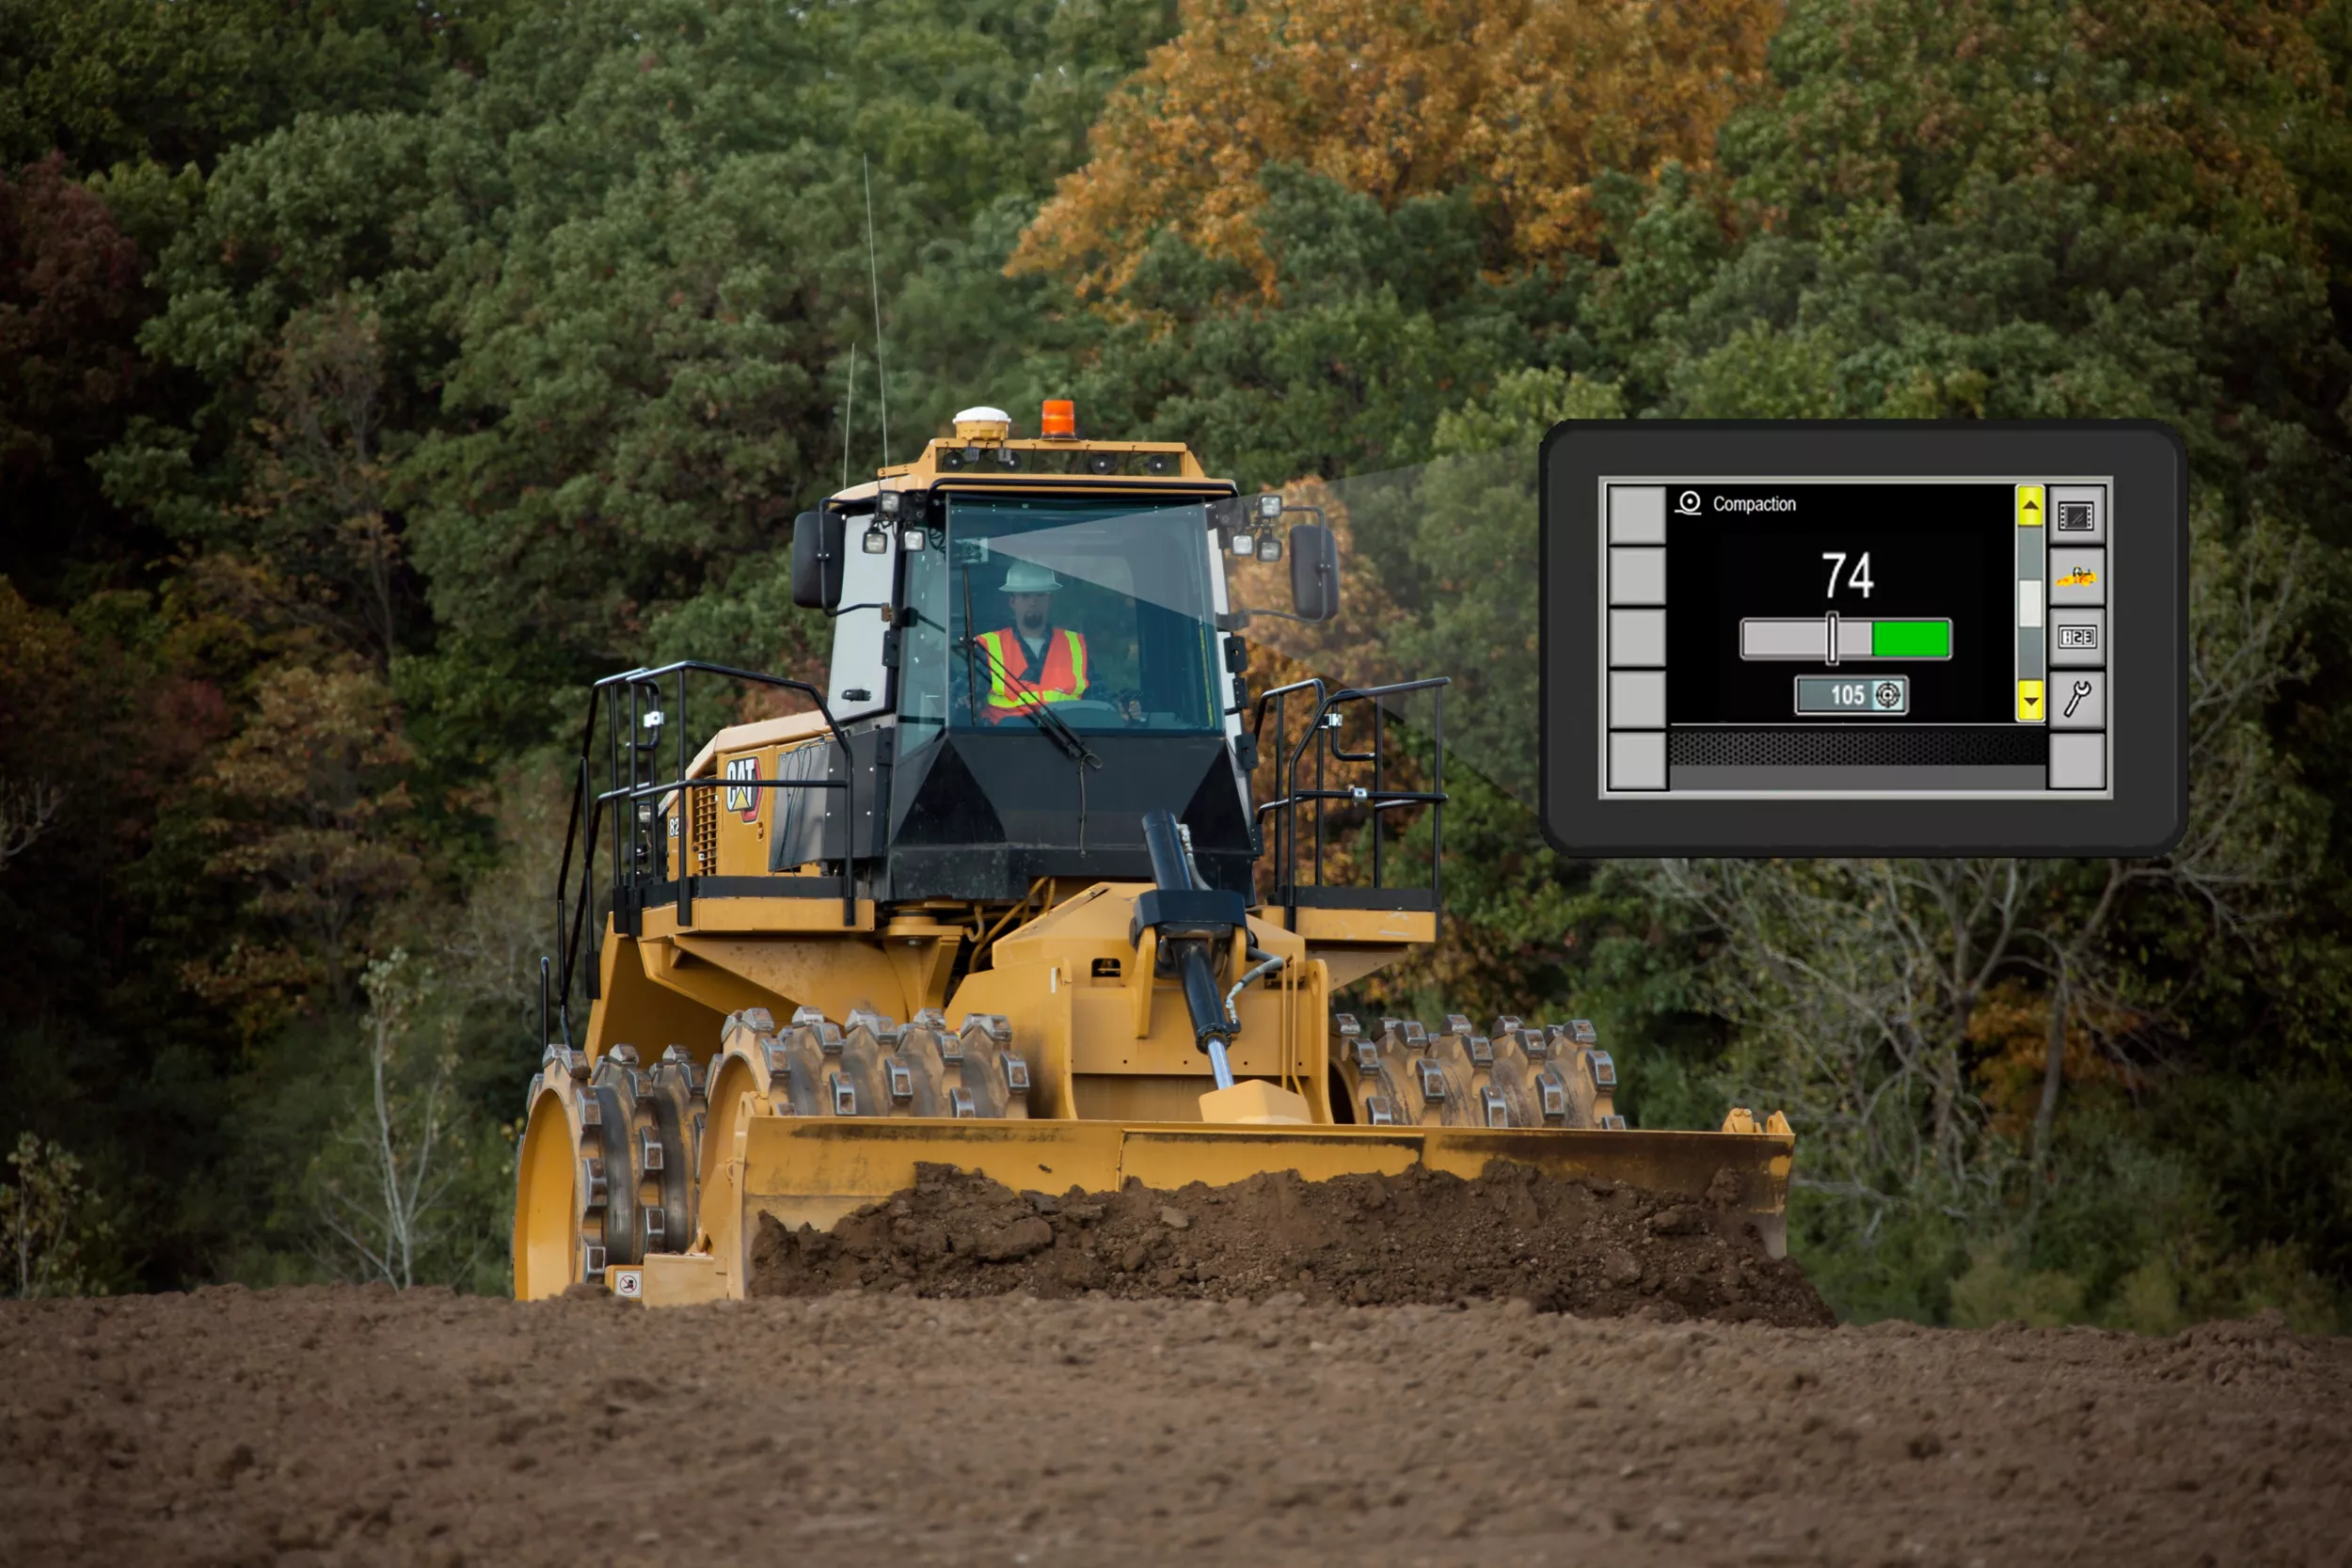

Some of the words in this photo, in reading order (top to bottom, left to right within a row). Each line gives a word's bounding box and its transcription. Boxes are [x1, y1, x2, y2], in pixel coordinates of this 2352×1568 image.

[1713, 495, 1797, 515] Compaction
[1822, 551, 1875, 598] 74
[1831, 684, 1866, 705] 105
[726, 758, 755, 811] CAT
